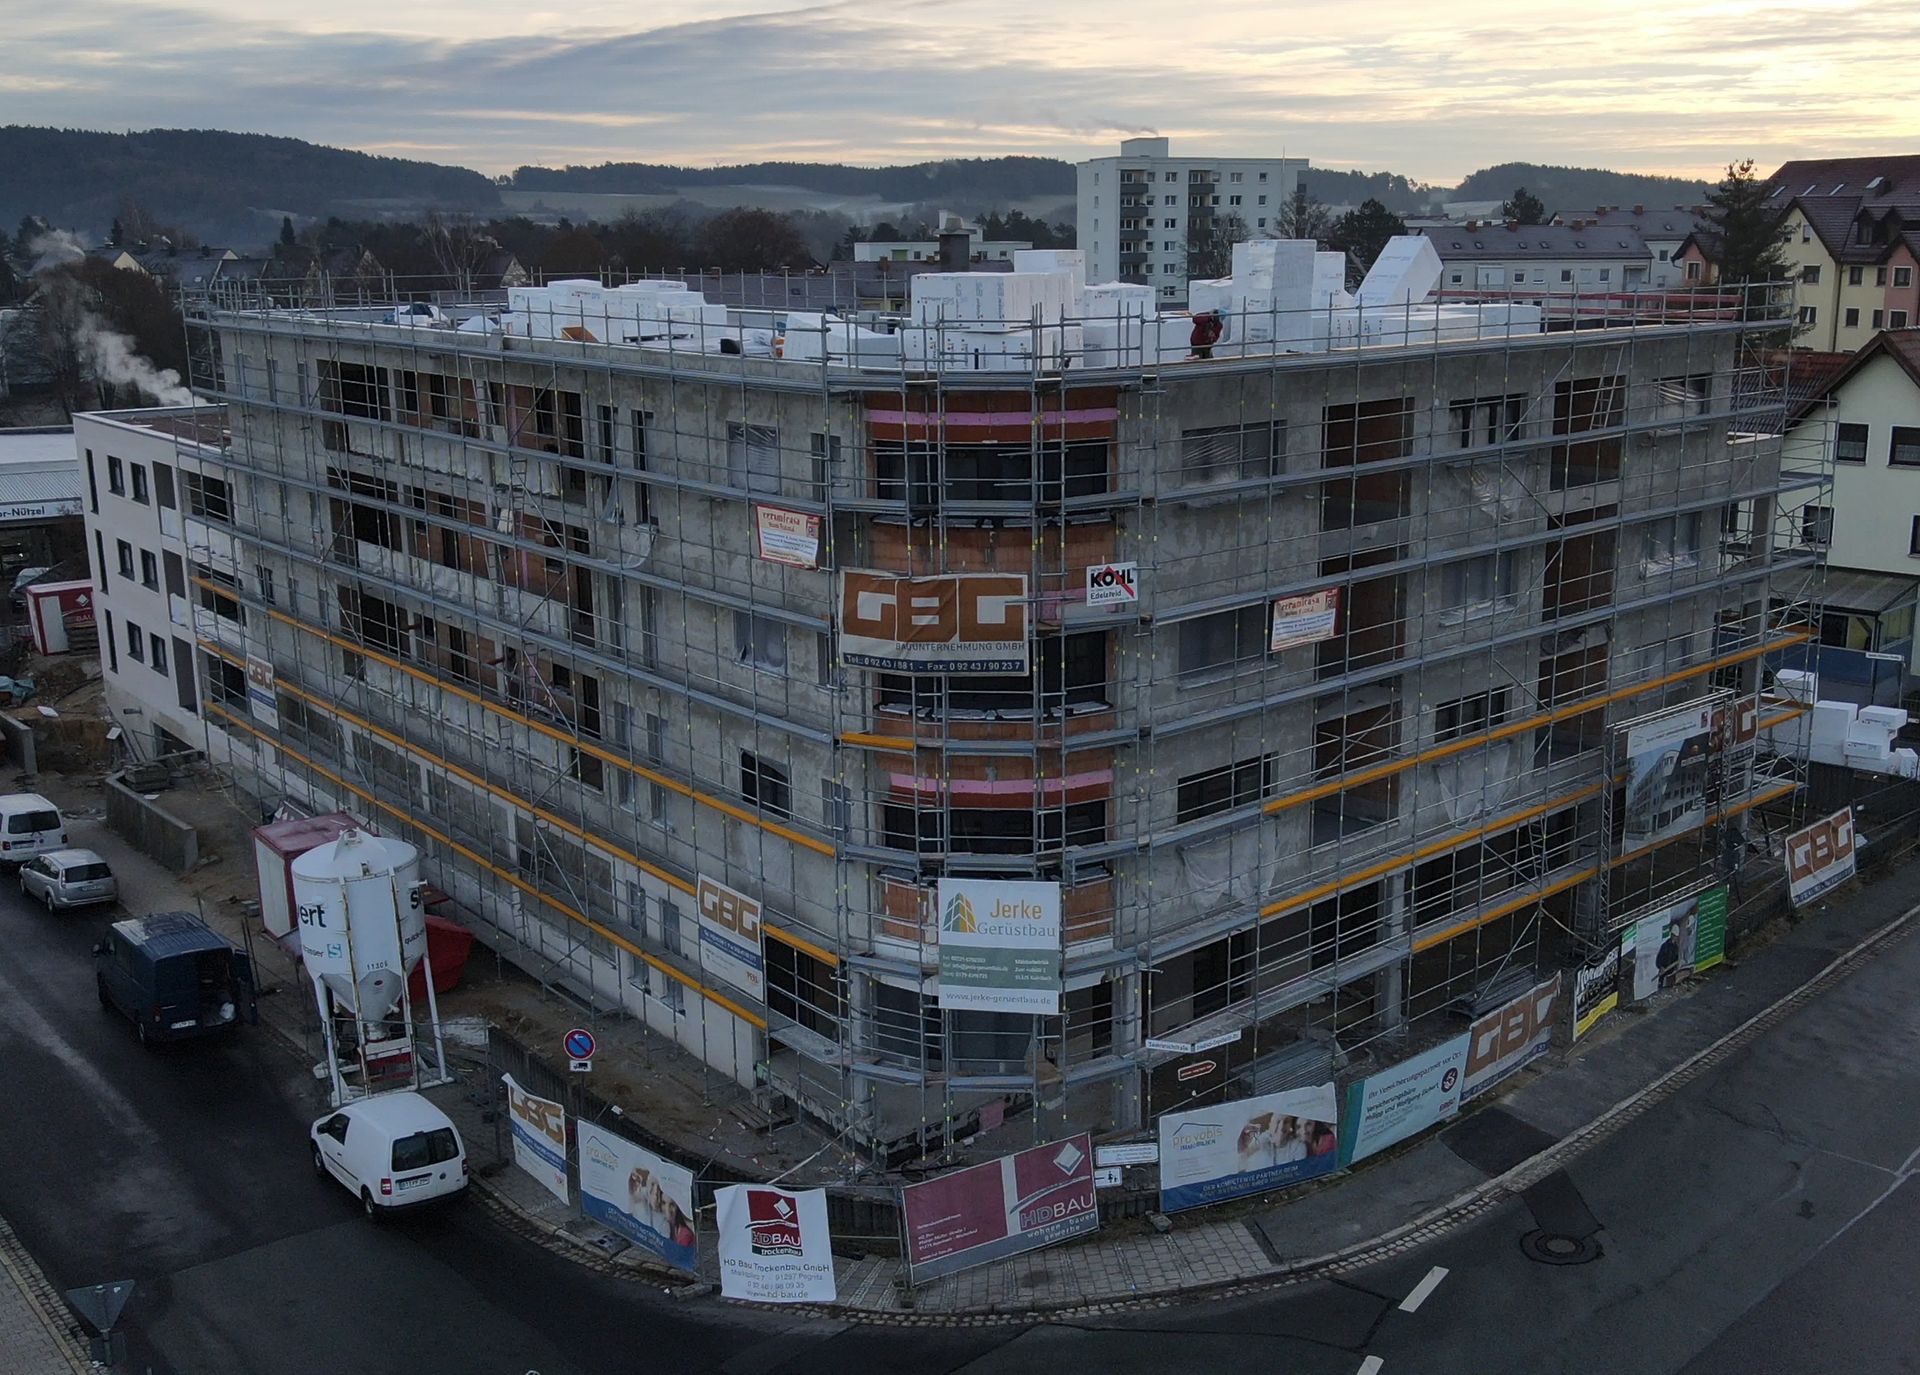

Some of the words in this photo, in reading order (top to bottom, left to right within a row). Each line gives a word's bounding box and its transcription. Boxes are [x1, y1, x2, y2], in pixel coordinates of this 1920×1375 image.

[843, 571, 1025, 643] GBG
[896, 643, 992, 652] BAUUNTERNEHMUNG
[995, 643, 1025, 651] GMBH
[700, 880, 759, 944] GBG
[990, 898, 1043, 920] Jerke
[977, 922, 1056, 937] Gerüstbau
[753, 1263, 801, 1273] Trockenbau
[803, 1263, 830, 1272] GmbH
